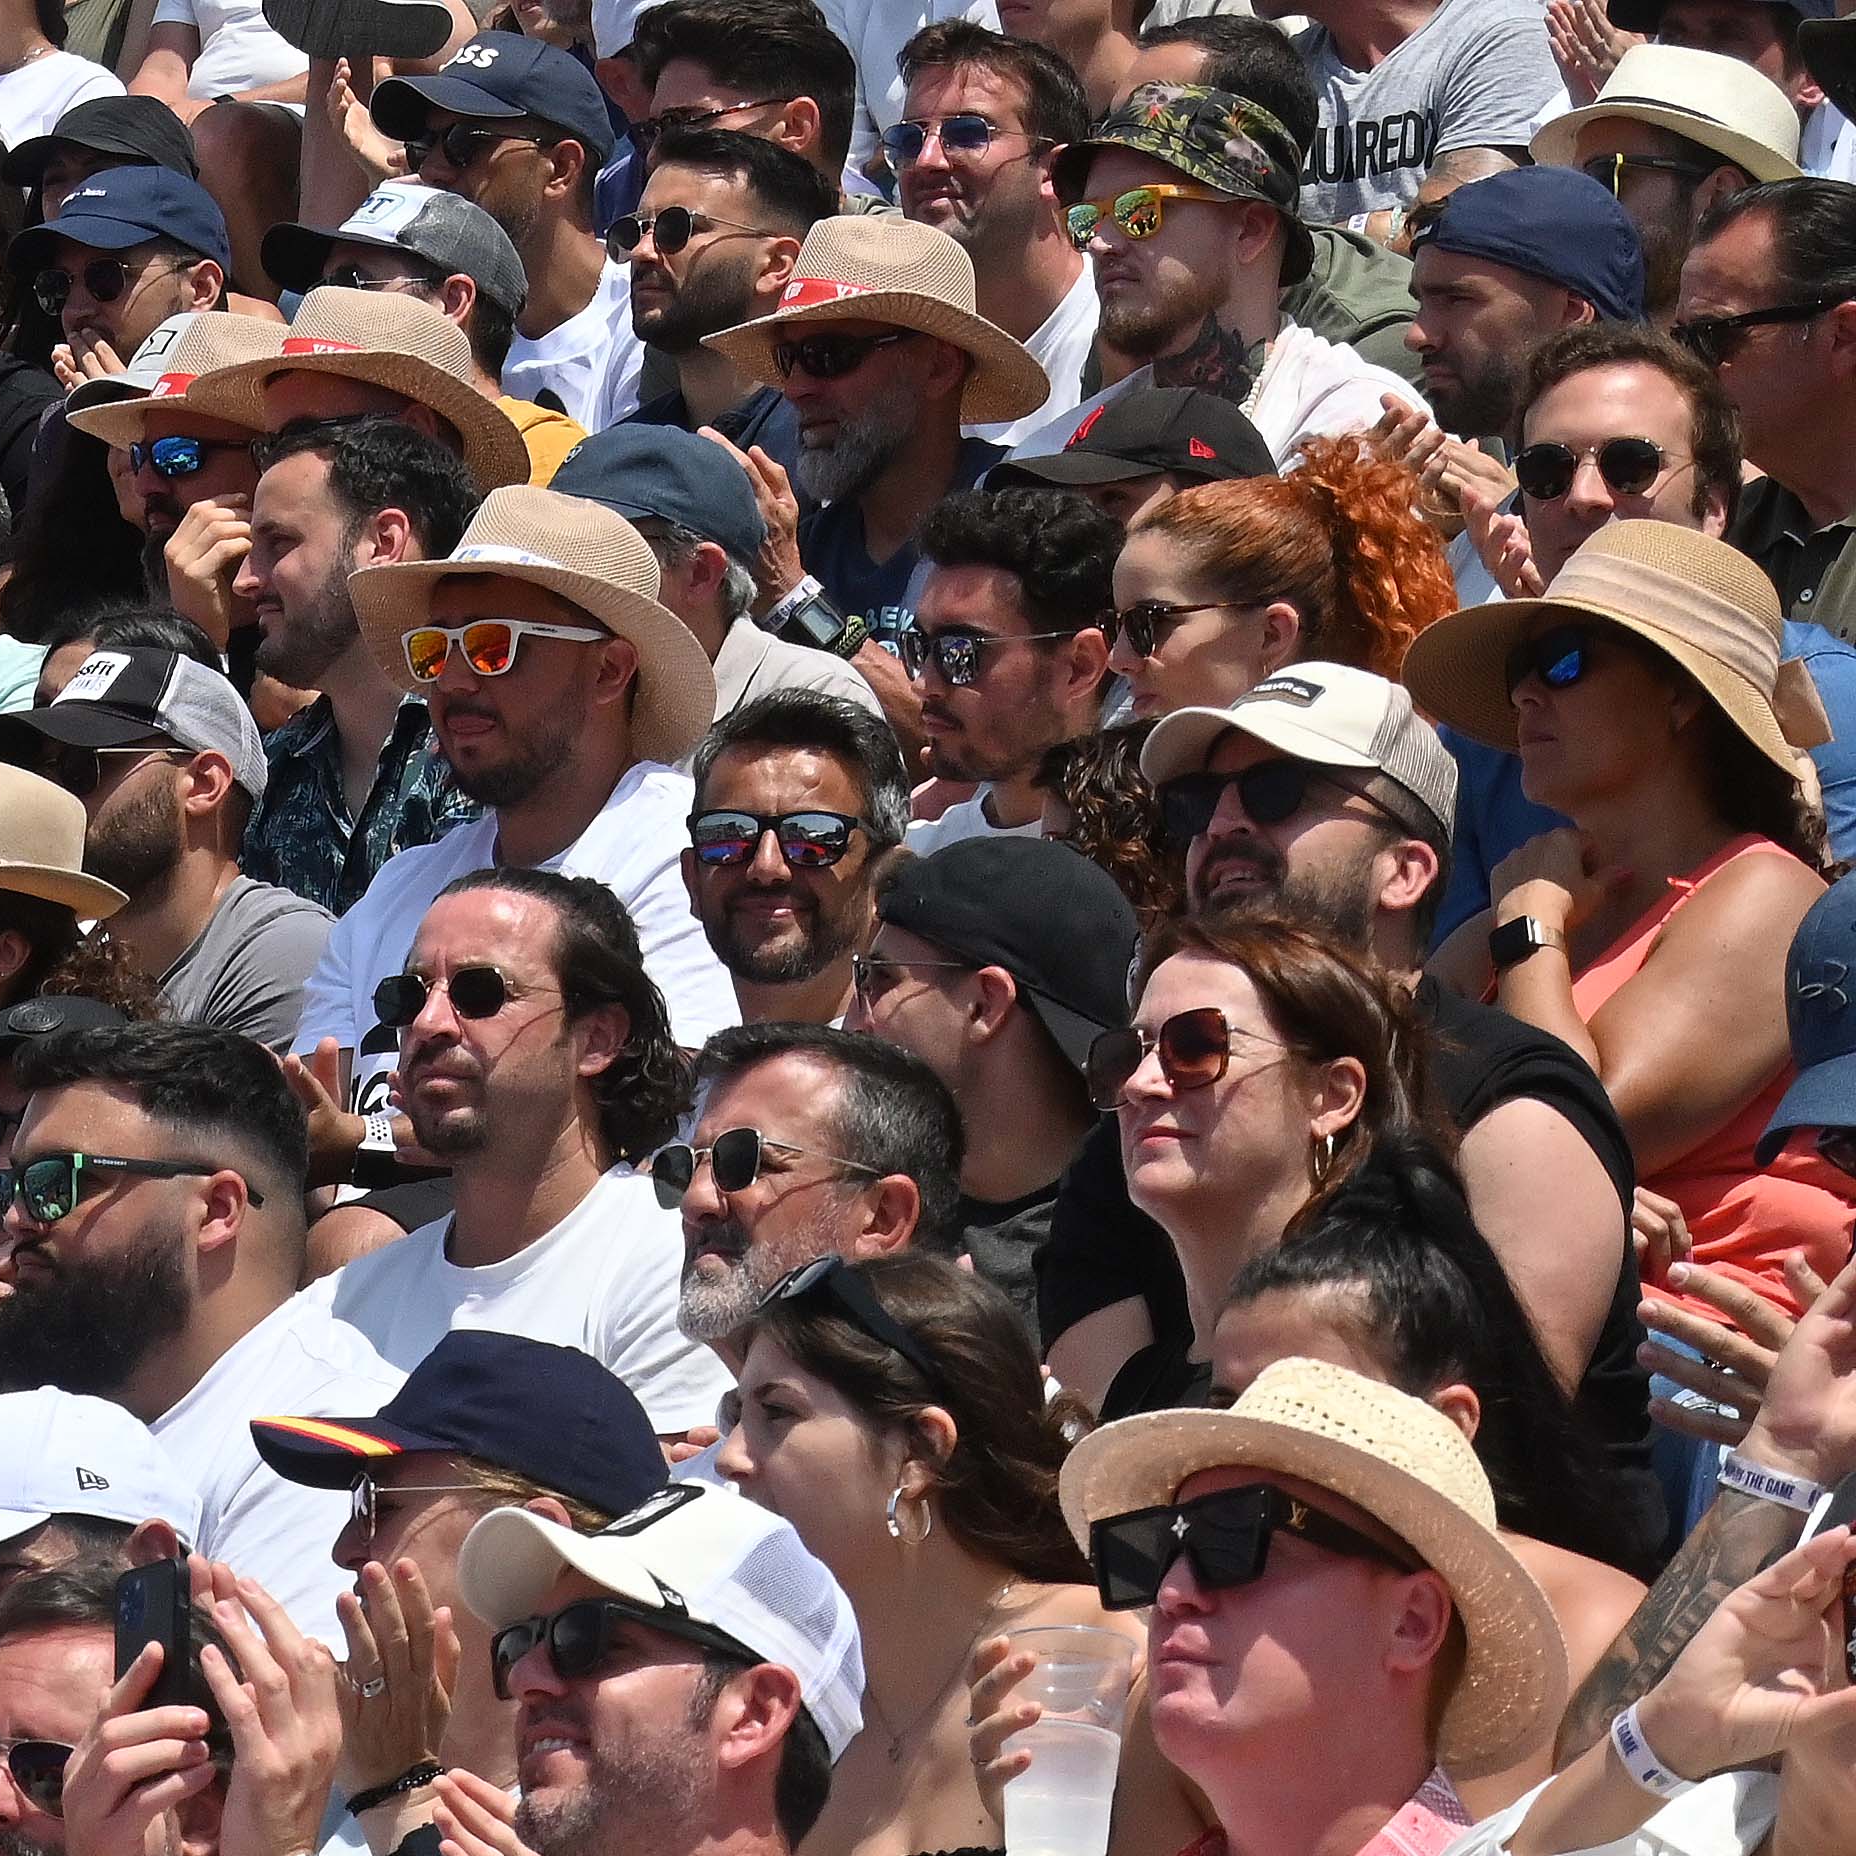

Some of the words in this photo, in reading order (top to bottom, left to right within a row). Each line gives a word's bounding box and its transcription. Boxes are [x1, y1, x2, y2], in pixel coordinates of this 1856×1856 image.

[1746, 1470, 1765, 1490] THE
[1764, 1477, 1797, 1502] GAME
[1617, 1726, 1640, 1758] GAME
